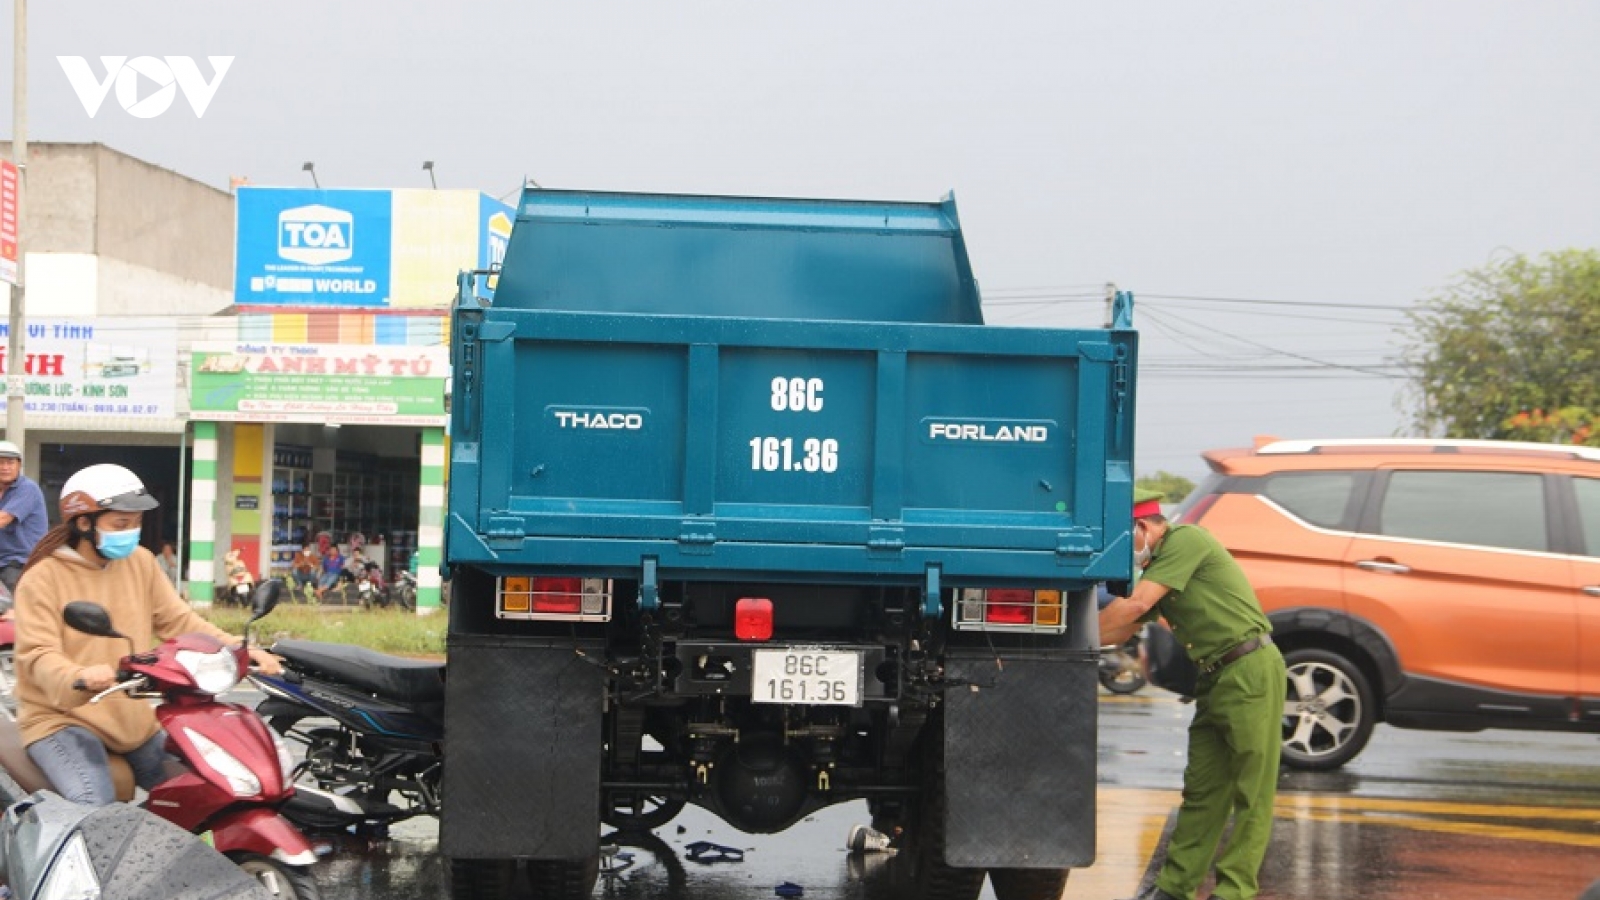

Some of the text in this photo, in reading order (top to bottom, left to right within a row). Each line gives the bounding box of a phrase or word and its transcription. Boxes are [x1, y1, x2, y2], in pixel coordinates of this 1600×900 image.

[284, 223, 346, 248] TOA
[315, 279, 377, 294] WORLD
[53, 321, 93, 339] TÍNH
[257, 356, 327, 374] ANH
[334, 353, 382, 375] MỸ
[388, 354, 433, 376] TÚ
[770, 376, 824, 412] 86C
[555, 411, 1048, 442] THACO FORLAND
[749, 436, 839, 473] 161.36
[784, 655, 828, 676] 86C
[767, 678, 846, 701] 161.36
